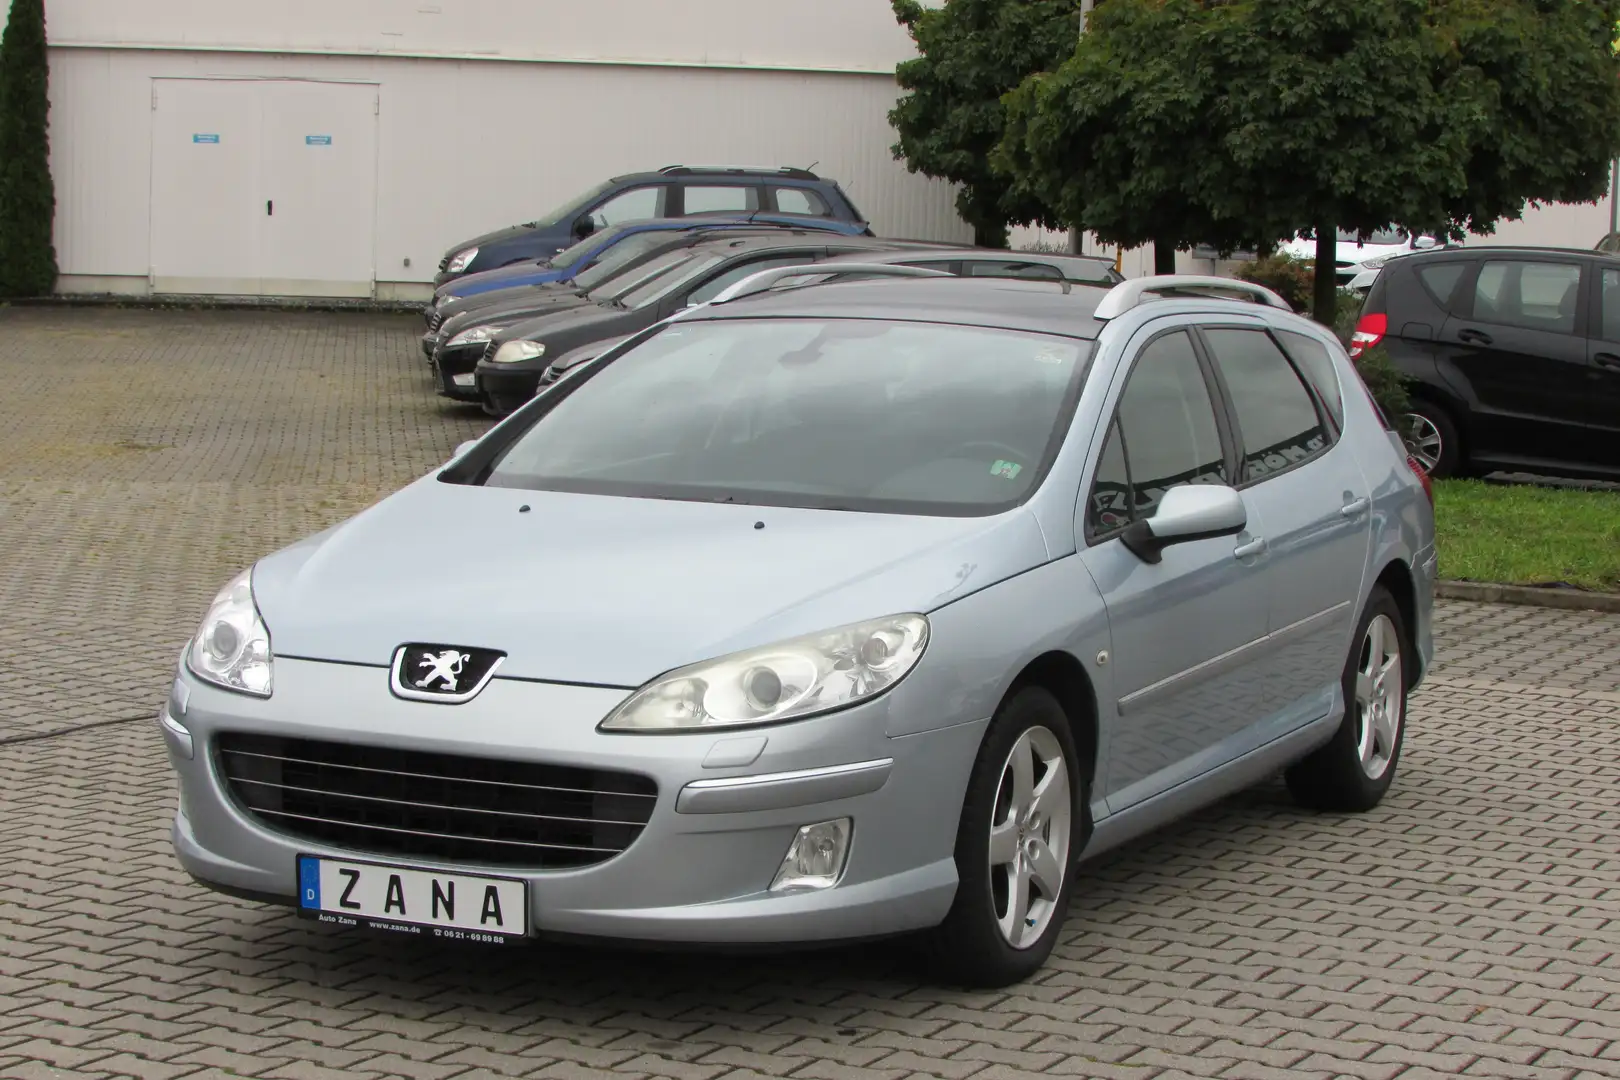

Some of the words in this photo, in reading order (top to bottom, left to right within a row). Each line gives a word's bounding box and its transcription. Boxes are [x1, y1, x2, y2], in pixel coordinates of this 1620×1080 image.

[307, 888, 315, 900] D
[319, 914, 336, 922] Auto
[338, 916, 357, 925] Zana
[369, 921, 420, 933] www.zana.de
